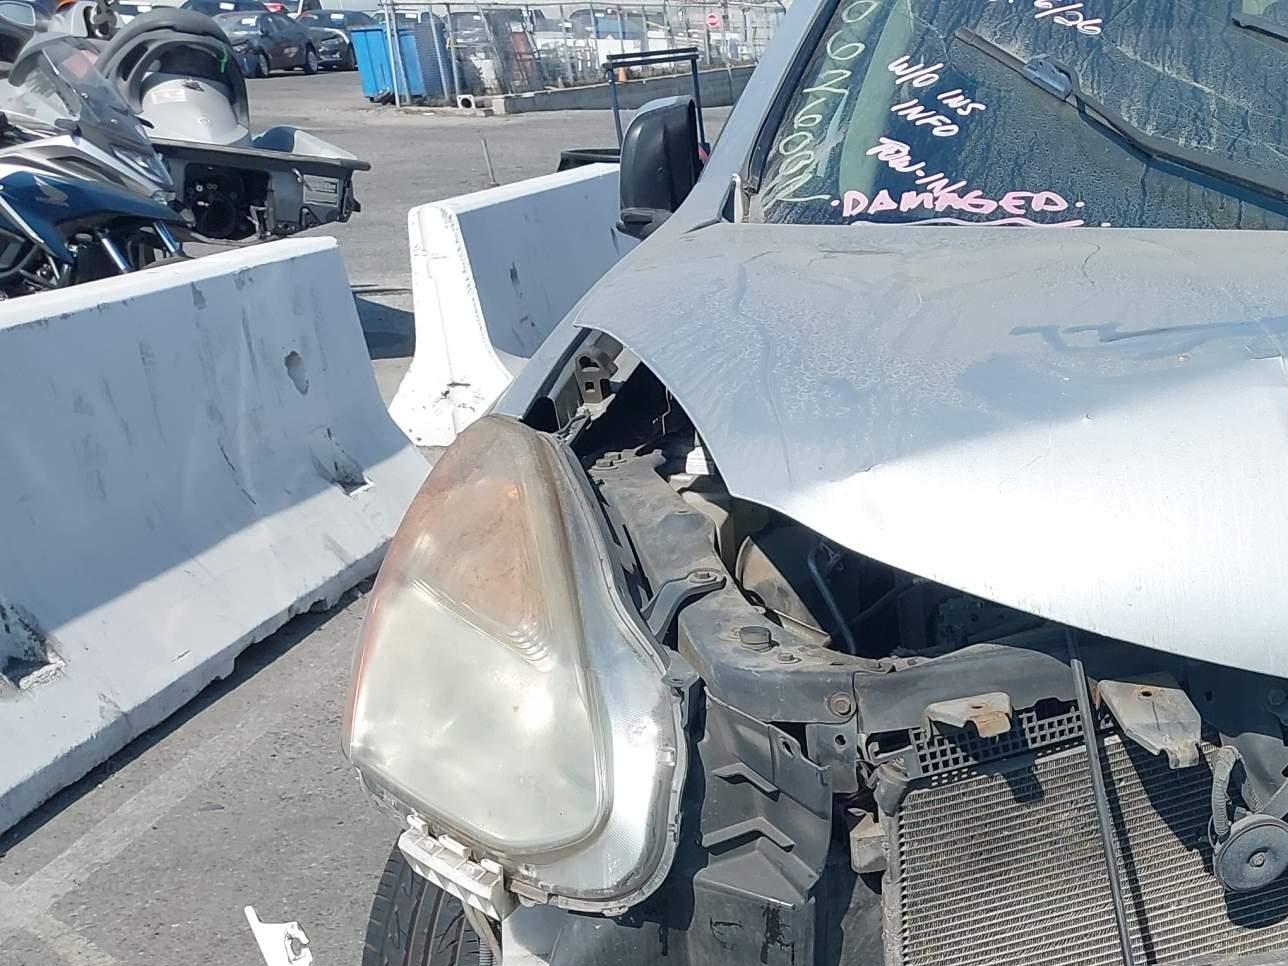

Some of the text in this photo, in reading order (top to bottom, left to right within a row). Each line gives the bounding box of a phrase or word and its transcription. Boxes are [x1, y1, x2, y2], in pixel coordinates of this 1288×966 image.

[887, 55, 986, 116] W/O INS
[890, 98, 959, 137] INFO
